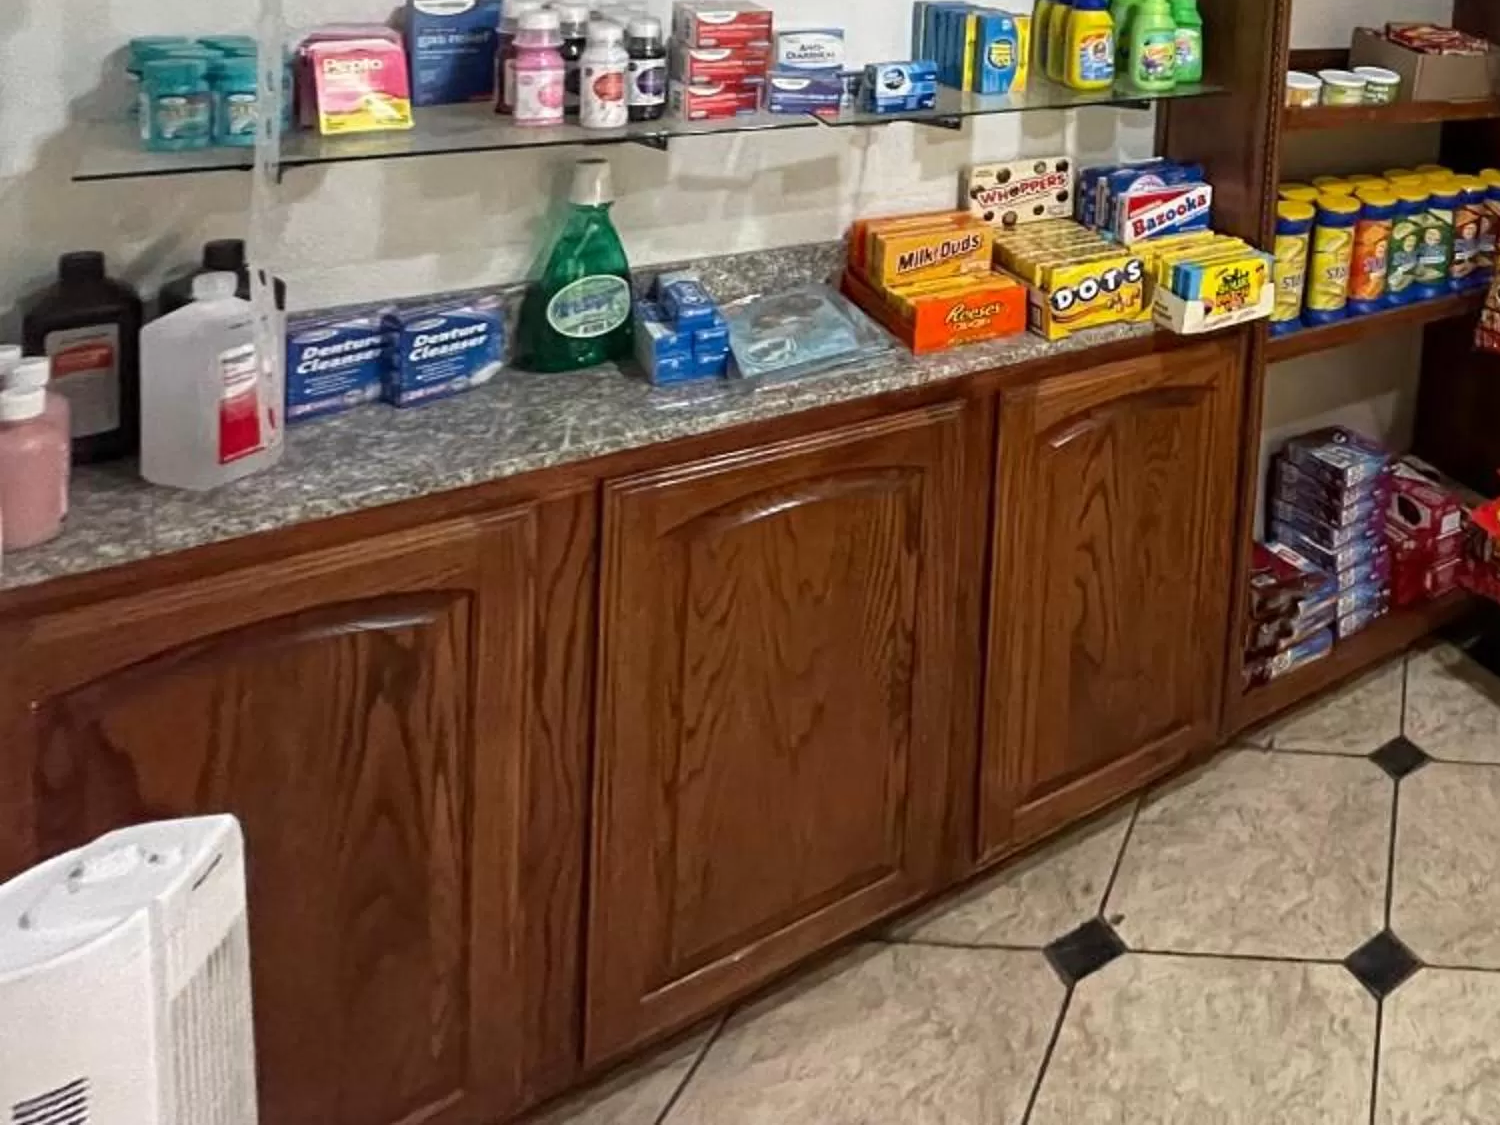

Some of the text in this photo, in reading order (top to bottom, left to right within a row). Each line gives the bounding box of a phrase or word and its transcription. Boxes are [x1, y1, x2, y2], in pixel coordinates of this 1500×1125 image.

[979, 173, 1067, 207] WHOPPERS
[1131, 192, 1208, 238] Bazooka
[897, 233, 981, 274] Milk Duds
[409, 335, 489, 363] Cleanser
[413, 321, 489, 350] Denture
